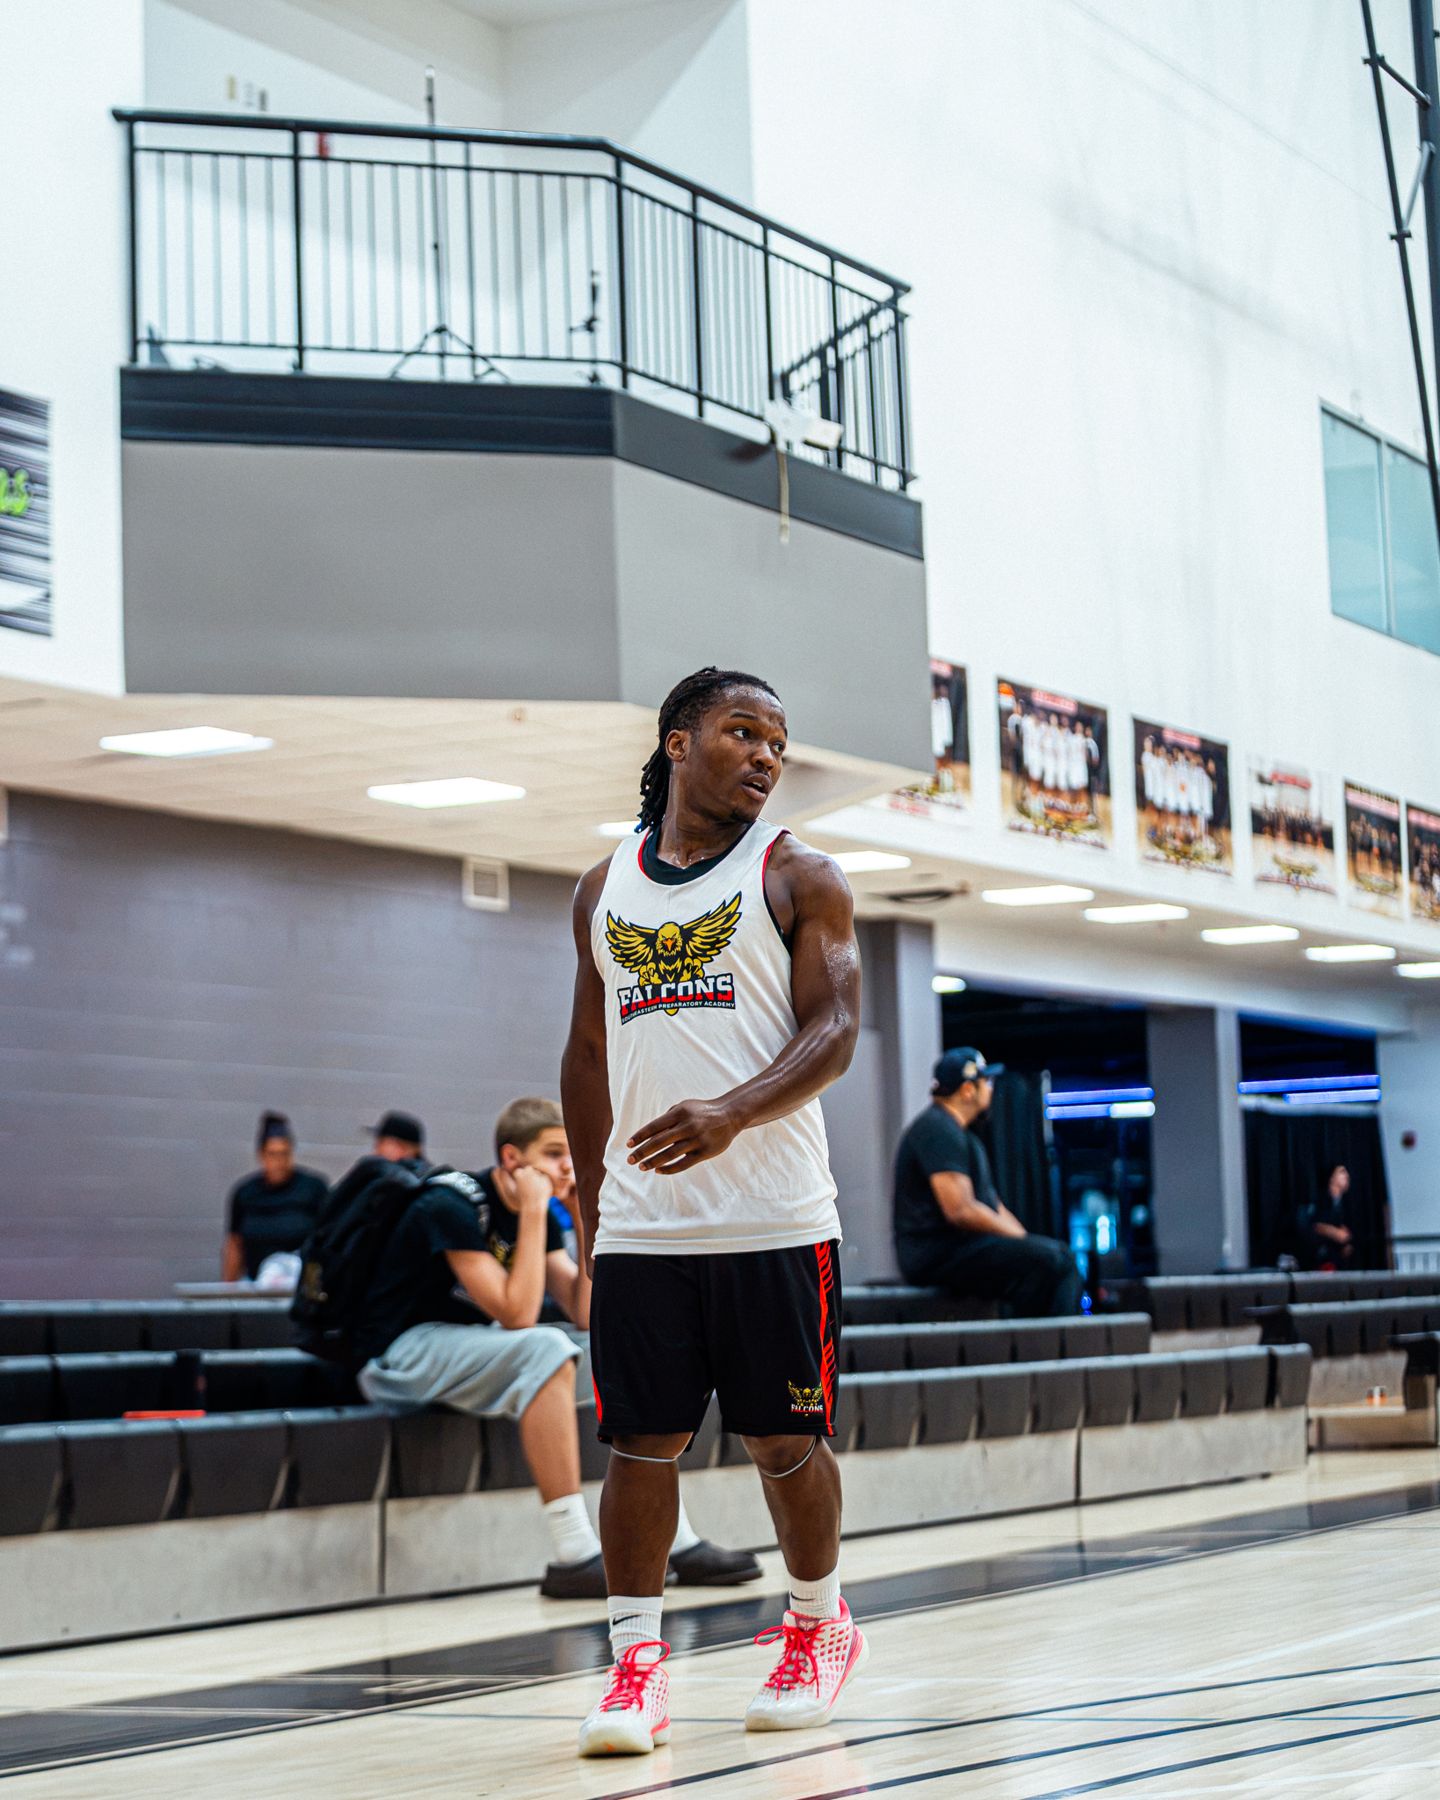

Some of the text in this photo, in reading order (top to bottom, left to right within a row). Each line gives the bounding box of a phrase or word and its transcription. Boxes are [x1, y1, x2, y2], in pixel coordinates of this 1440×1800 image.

[618, 975, 734, 1016] FALCONS
[658, 1001, 703, 1009] PREPARATORY
[791, 1403, 824, 1414] FALCONS
